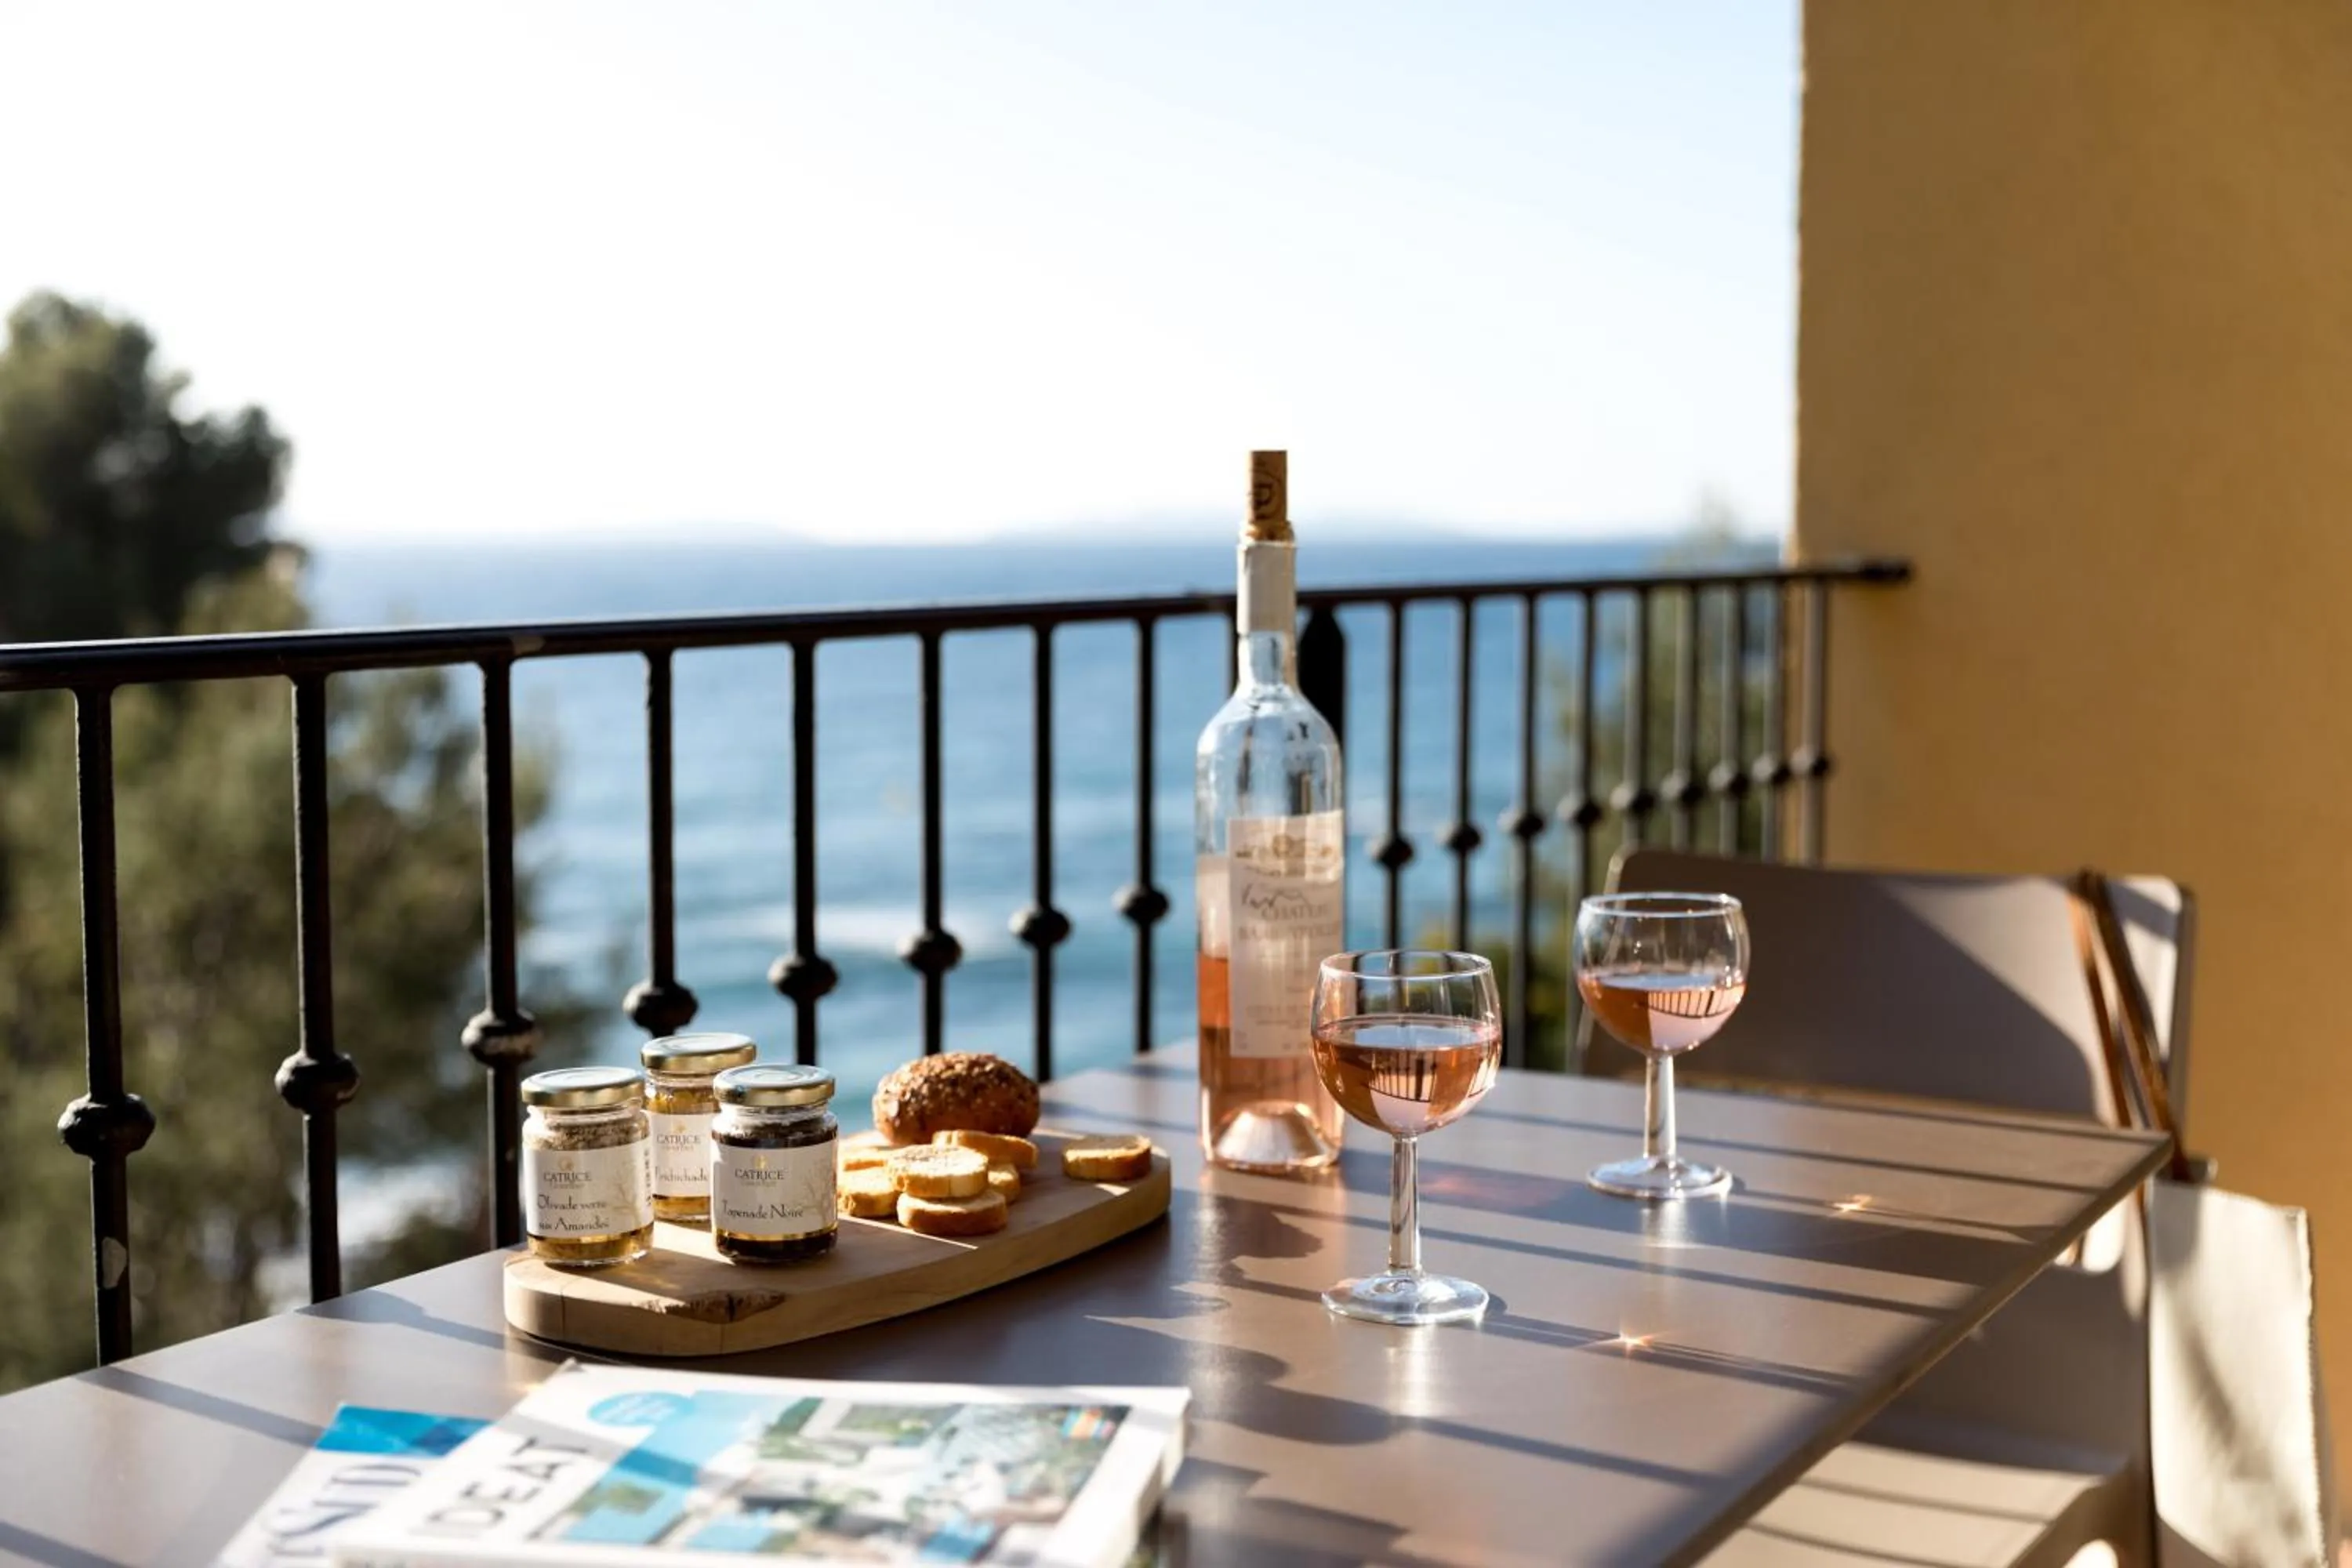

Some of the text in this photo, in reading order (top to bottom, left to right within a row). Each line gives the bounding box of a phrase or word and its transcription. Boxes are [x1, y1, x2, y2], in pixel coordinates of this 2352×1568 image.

[656, 1134, 701, 1145] CATRICE
[543, 1171, 593, 1183] CATRICE
[734, 1167, 786, 1181] CATRICE
[770, 1203, 804, 1219] Noire
